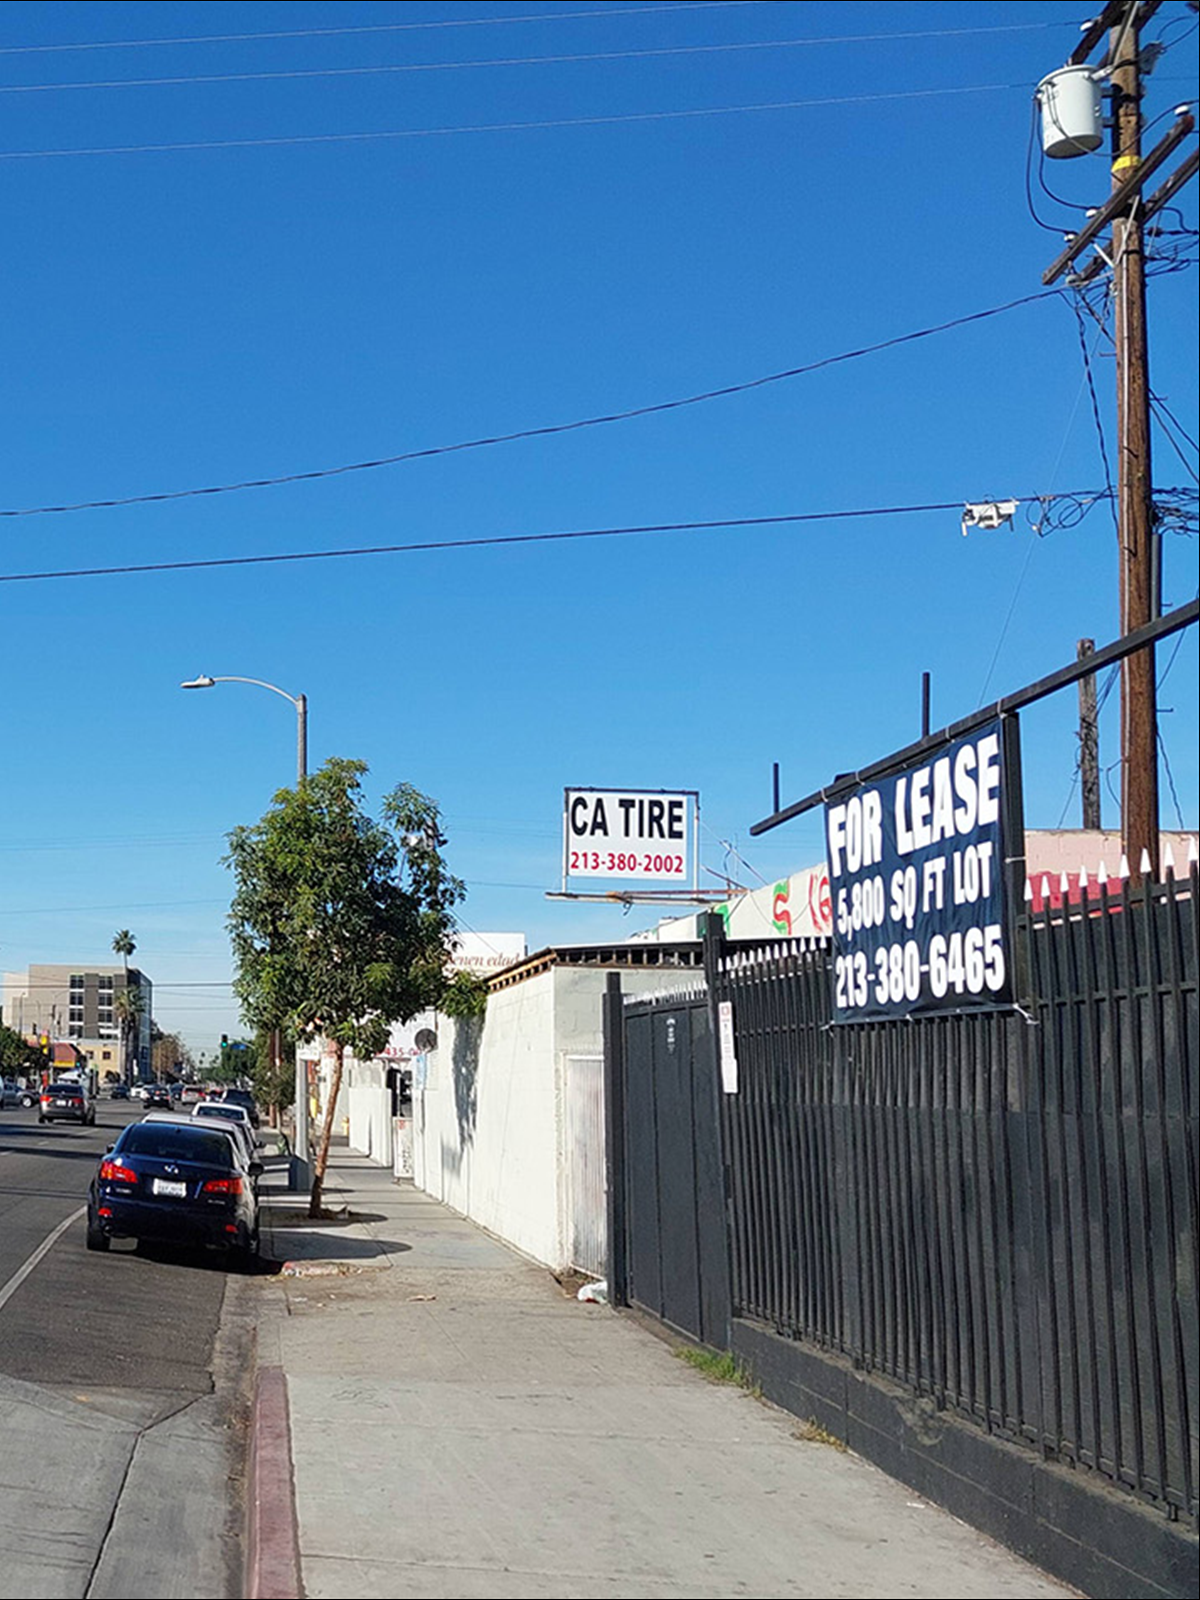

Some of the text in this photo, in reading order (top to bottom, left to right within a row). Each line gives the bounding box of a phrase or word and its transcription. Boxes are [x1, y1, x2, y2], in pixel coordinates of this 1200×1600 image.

[571, 796, 684, 839] CA TIRE
[828, 733, 999, 878] FOR LEASE
[570, 851, 684, 873] 213-380-2002
[837, 874, 885, 941] 5,800
[890, 865, 917, 929] SQ
[922, 856, 946, 913] FT
[953, 841, 992, 905] LOT
[836, 923, 1005, 1009] 213-380-6465
